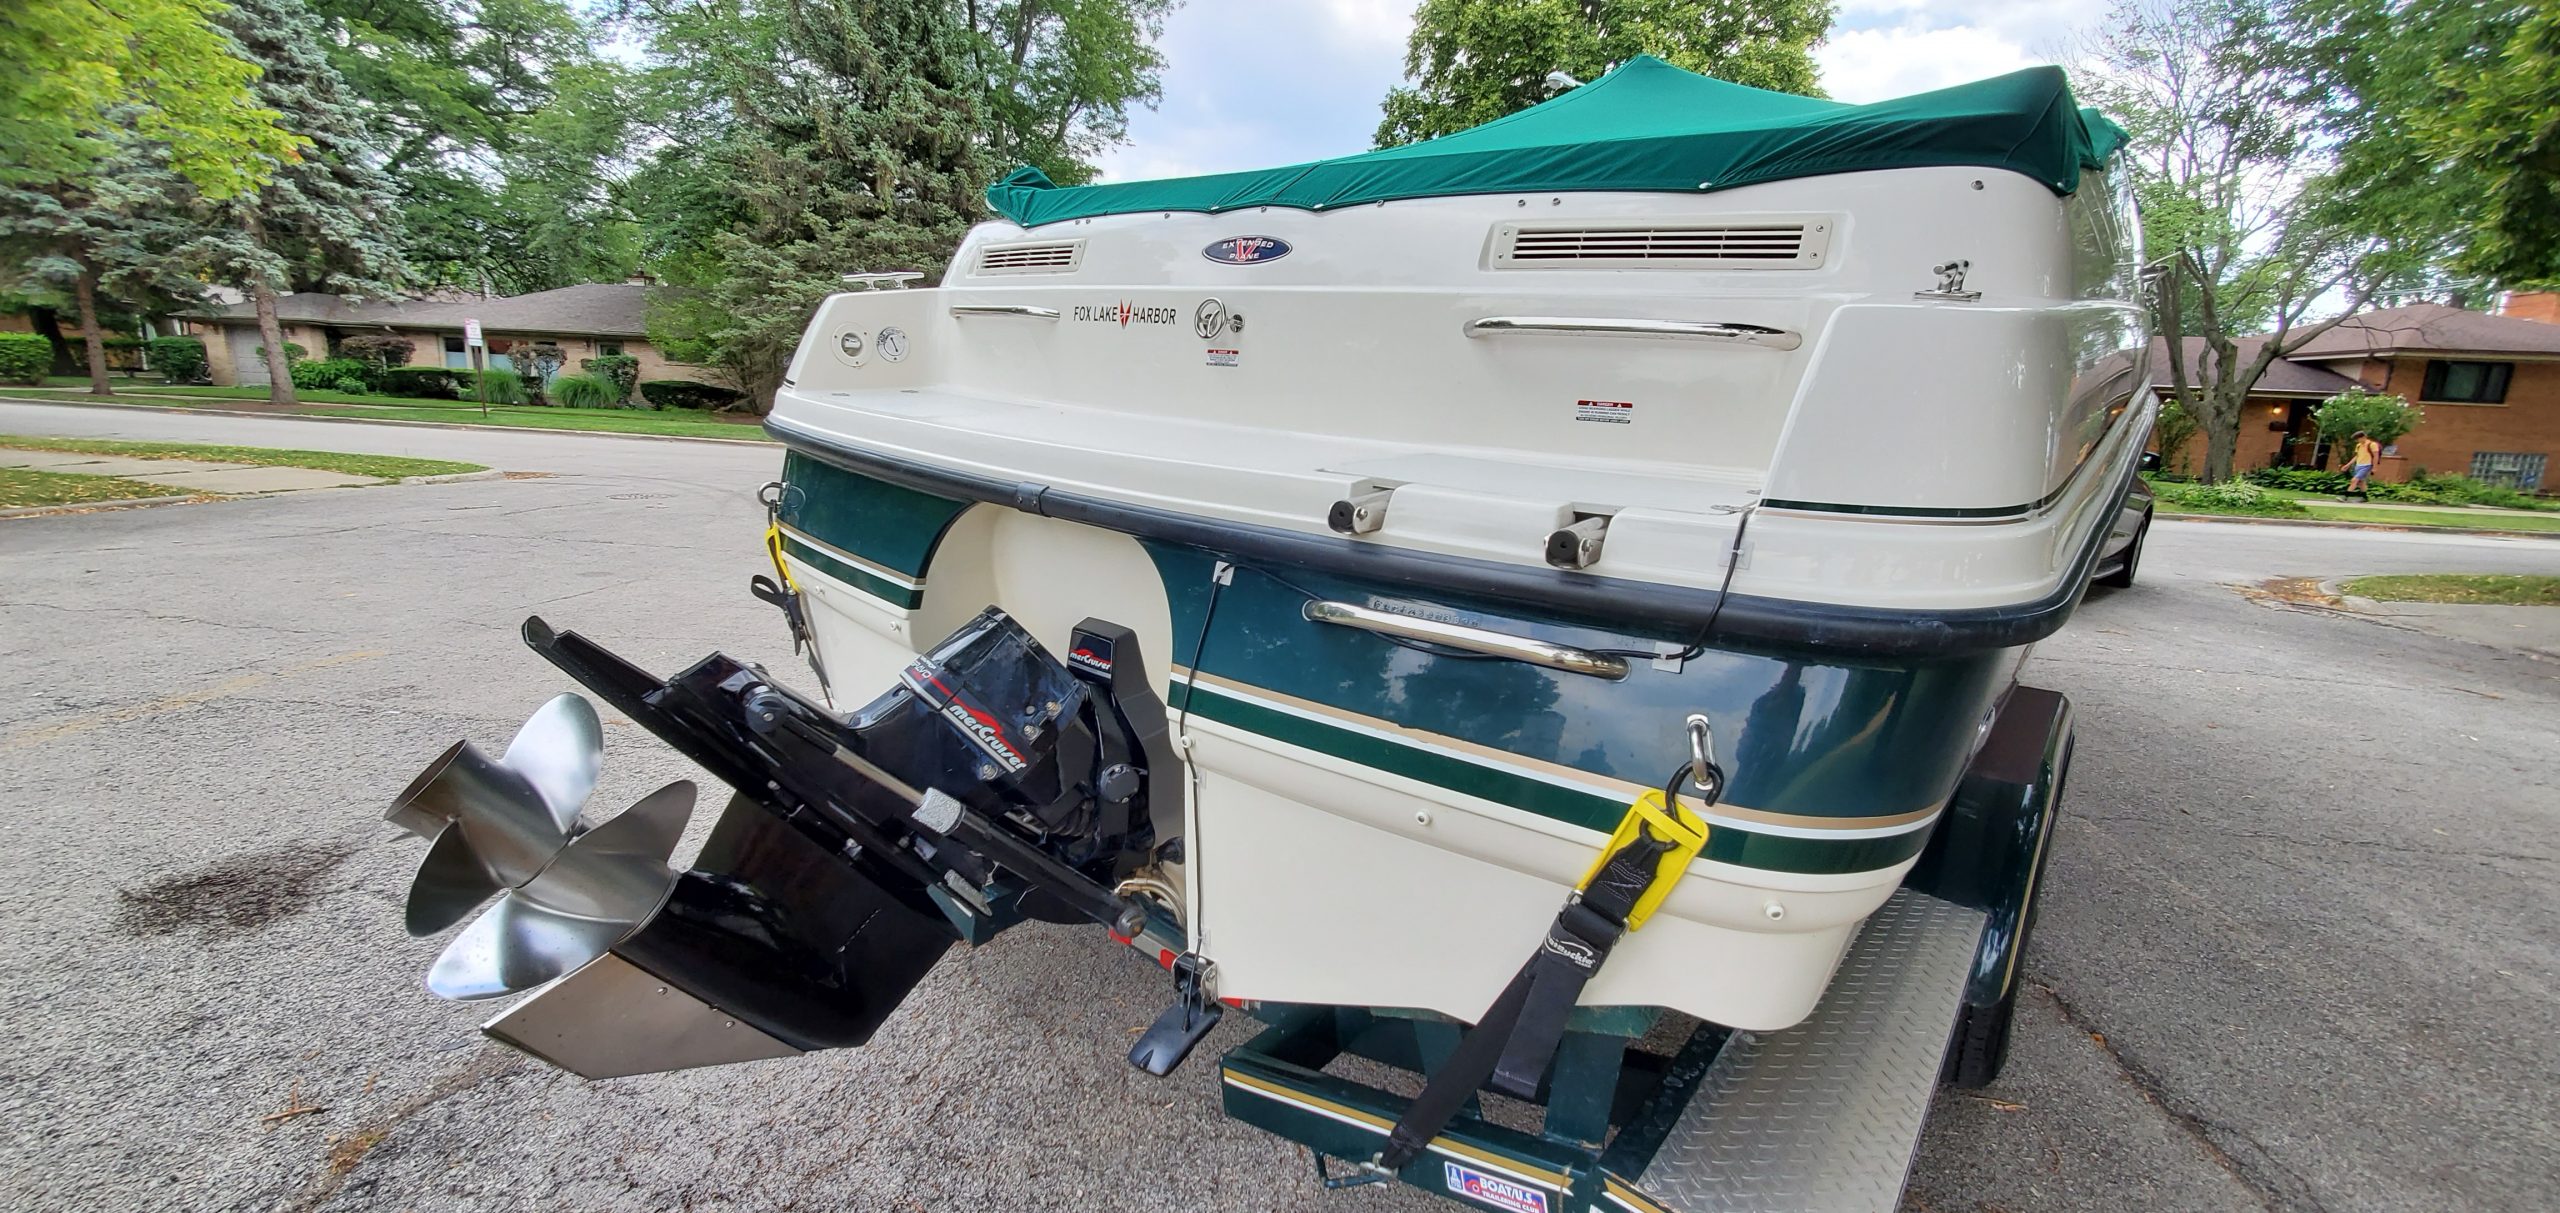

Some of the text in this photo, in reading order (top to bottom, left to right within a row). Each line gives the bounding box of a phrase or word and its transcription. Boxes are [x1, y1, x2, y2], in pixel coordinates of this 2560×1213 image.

[1222, 239, 1274, 249] EXTENDED
[1074, 306, 1177, 325] FOX LAKE HARBOR
[948, 704, 1028, 770] merCruiser
[1480, 1176, 1537, 1206] BOAT/U.S.
[1481, 1190, 1521, 1209] TRAILERING
